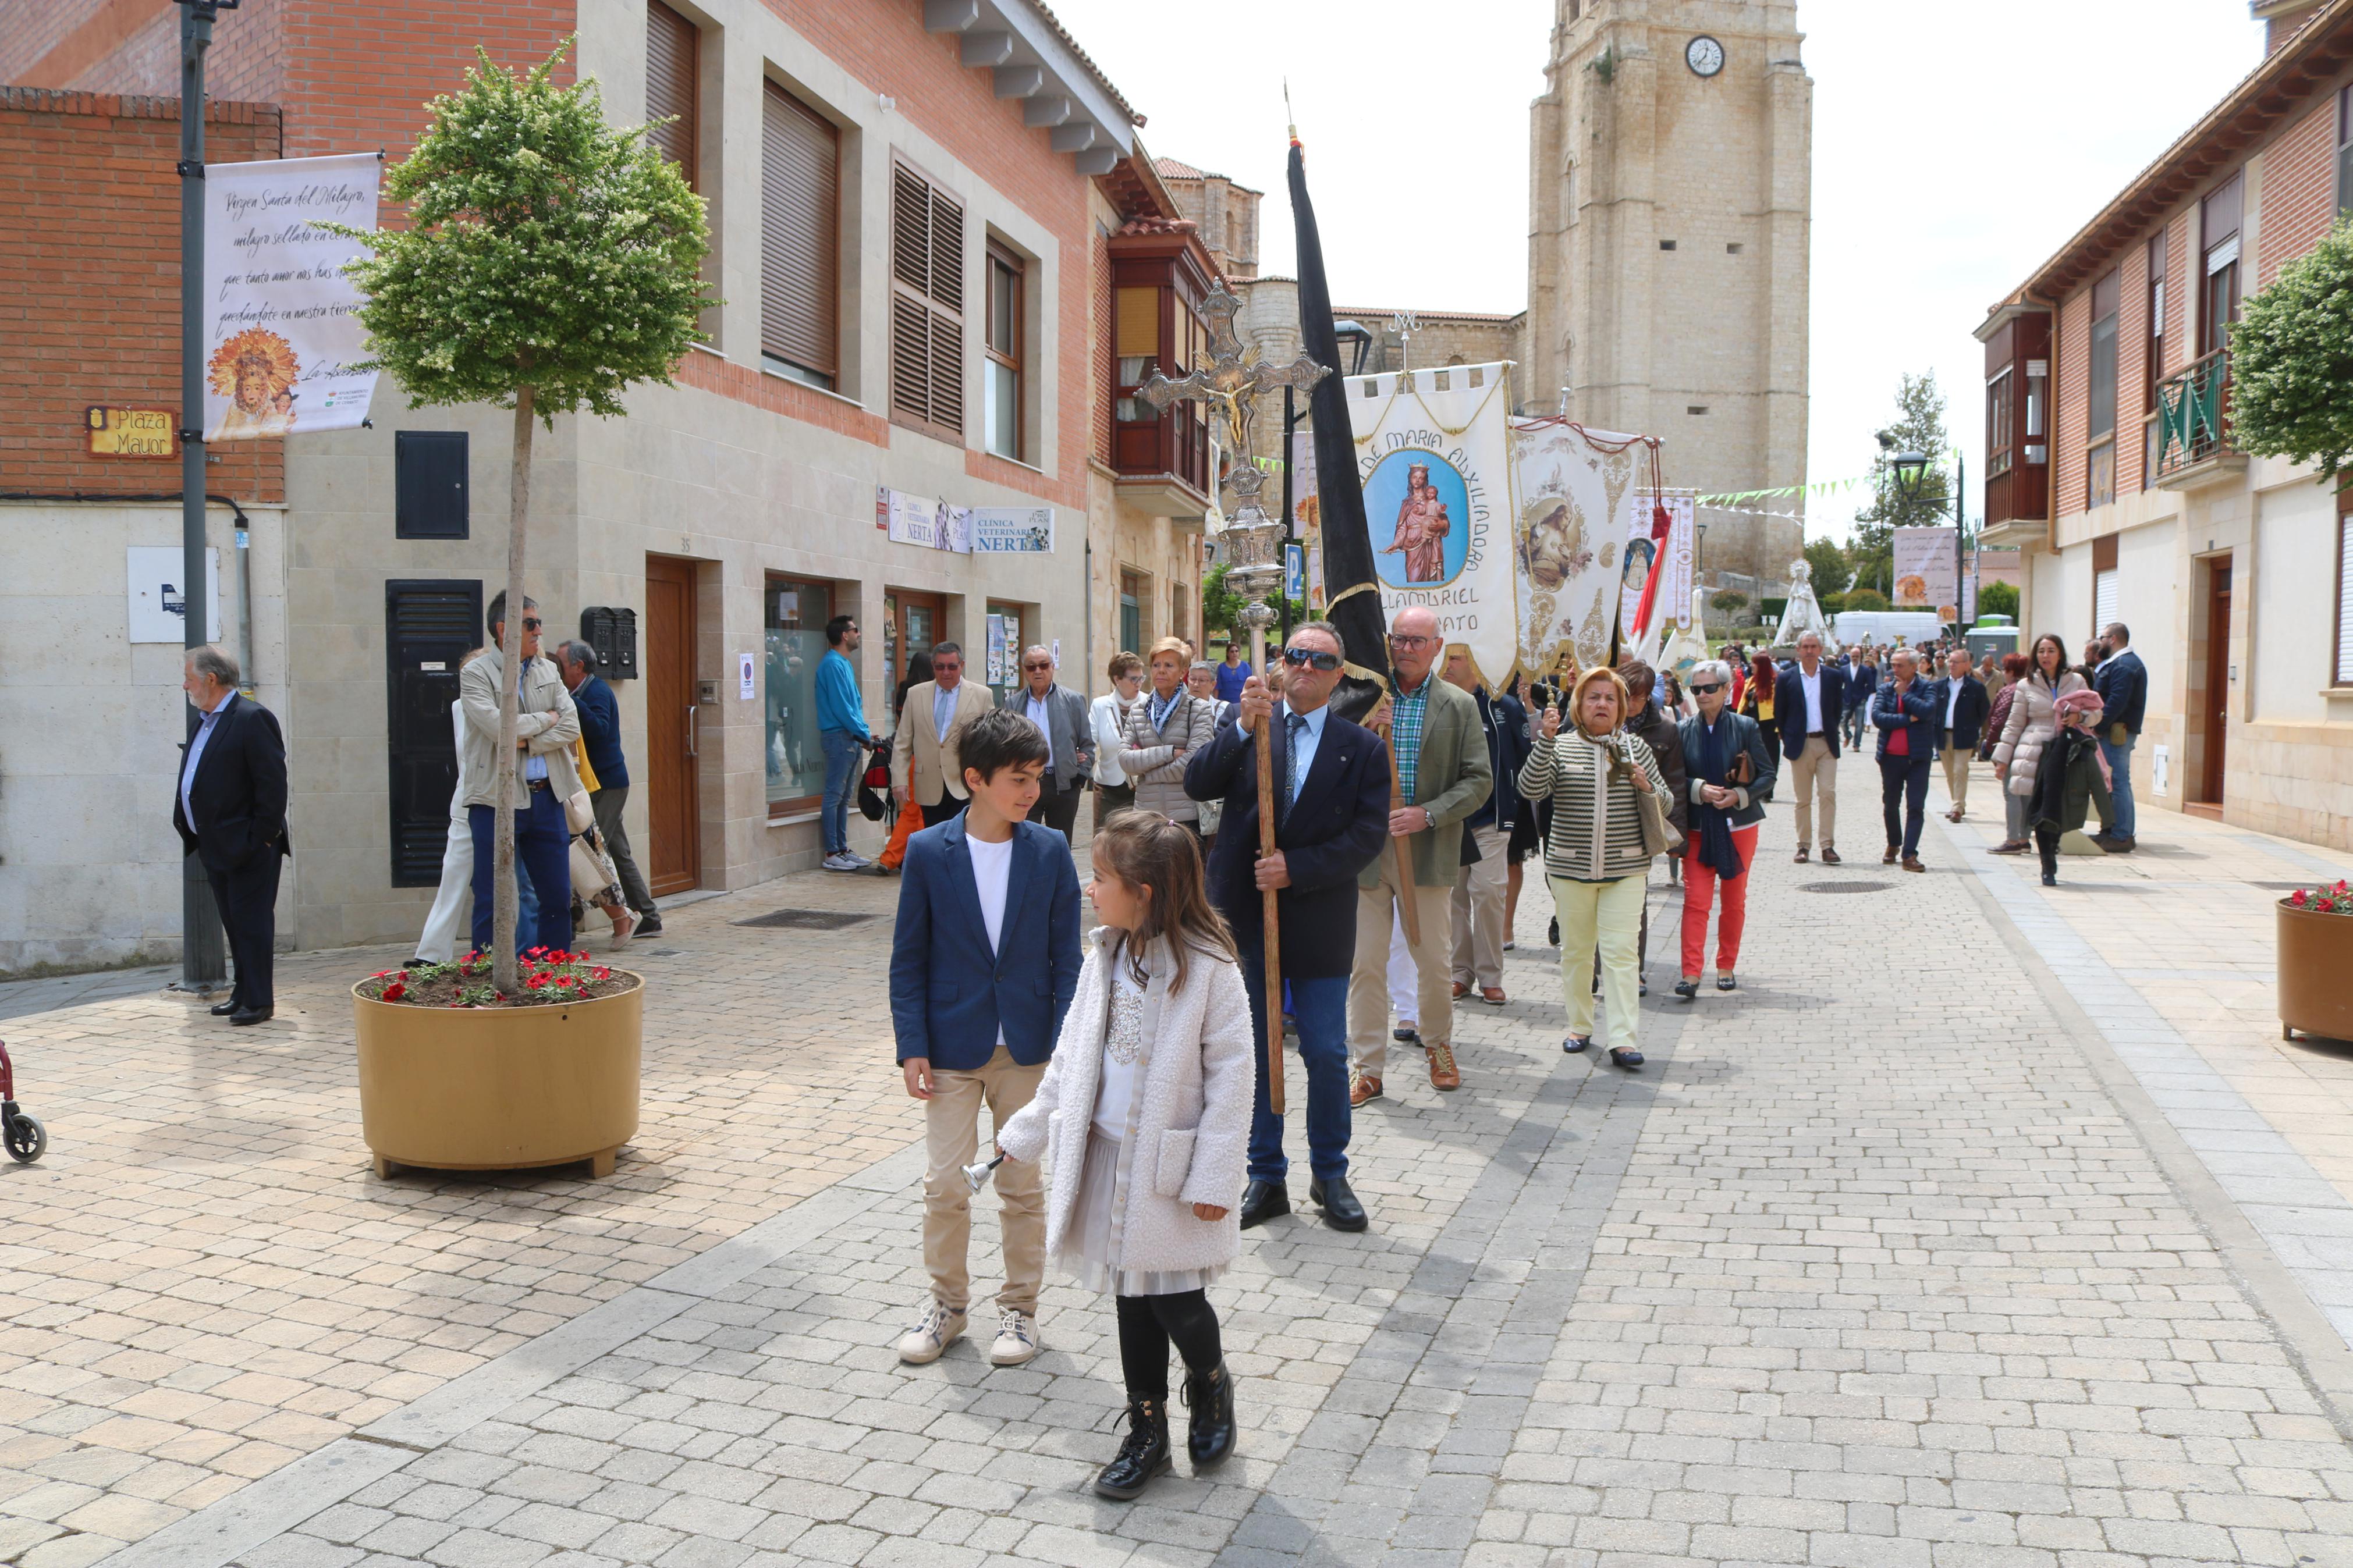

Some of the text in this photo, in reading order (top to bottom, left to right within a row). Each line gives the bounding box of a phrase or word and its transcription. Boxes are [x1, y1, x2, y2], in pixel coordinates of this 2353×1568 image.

[225, 184, 364, 222] Virgen Santa del Milagro,
[233, 227, 269, 258] milagro
[272, 225, 311, 245] sellado
[314, 231, 325, 242] en
[219, 275, 242, 302] que
[246, 270, 269, 285] tanto
[272, 270, 294, 282] amor
[297, 269, 312, 280] nos
[314, 259, 332, 279] has
[281, 310, 292, 321] en
[294, 303, 326, 319] nuestra
[301, 360, 324, 381] La
[115, 410, 166, 429] Plaza
[113, 433, 166, 454] Mayor
[1361, 429, 1490, 571] DE MARIA AUXILIADORA
[907, 522, 932, 542] NERTA
[955, 518, 966, 529] PRO
[978, 518, 1014, 527] CLÍNICA
[953, 527, 968, 541] PLAN
[978, 537, 1042, 552] NERTA
[1289, 551, 1298, 593] P
